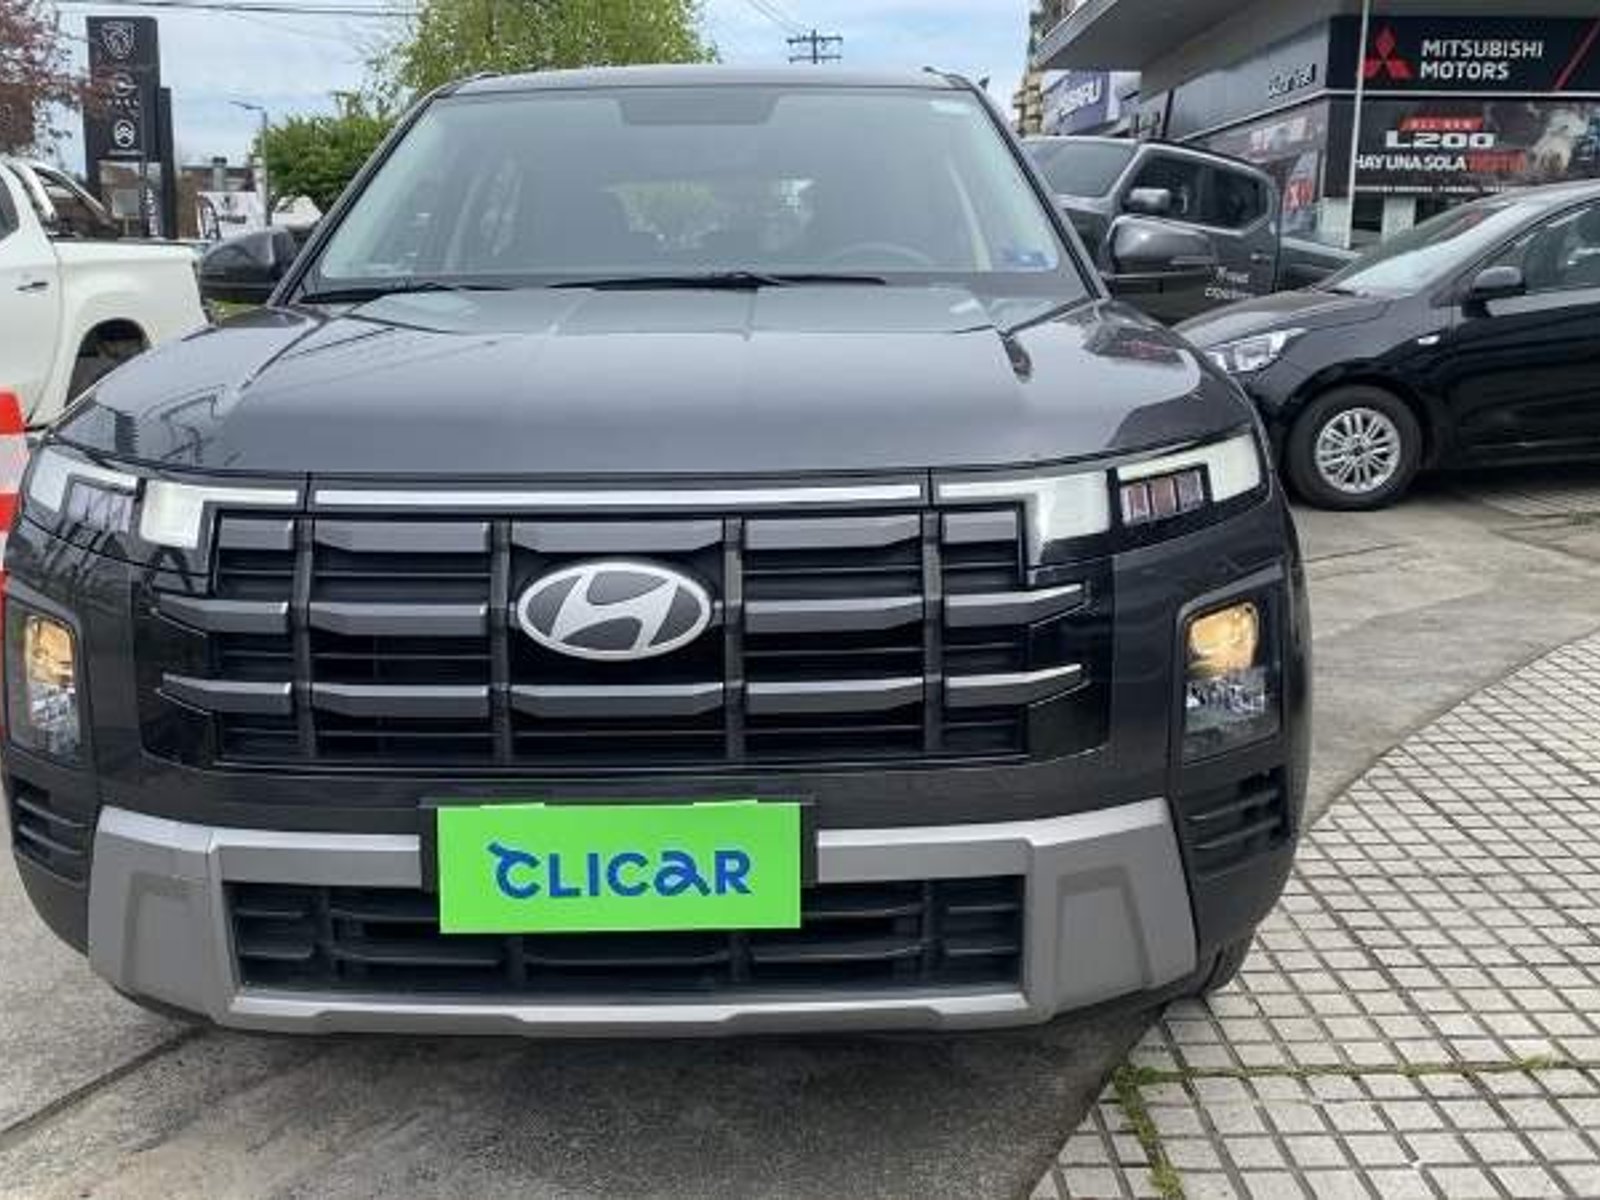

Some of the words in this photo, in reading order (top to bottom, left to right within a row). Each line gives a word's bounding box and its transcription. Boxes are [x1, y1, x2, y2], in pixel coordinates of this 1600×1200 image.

[1421, 39, 1544, 59] MITSUBISHI
[1420, 60, 1510, 80] MOTORS
[1385, 130, 1496, 149] L200
[1423, 153, 1468, 172] SOLA
